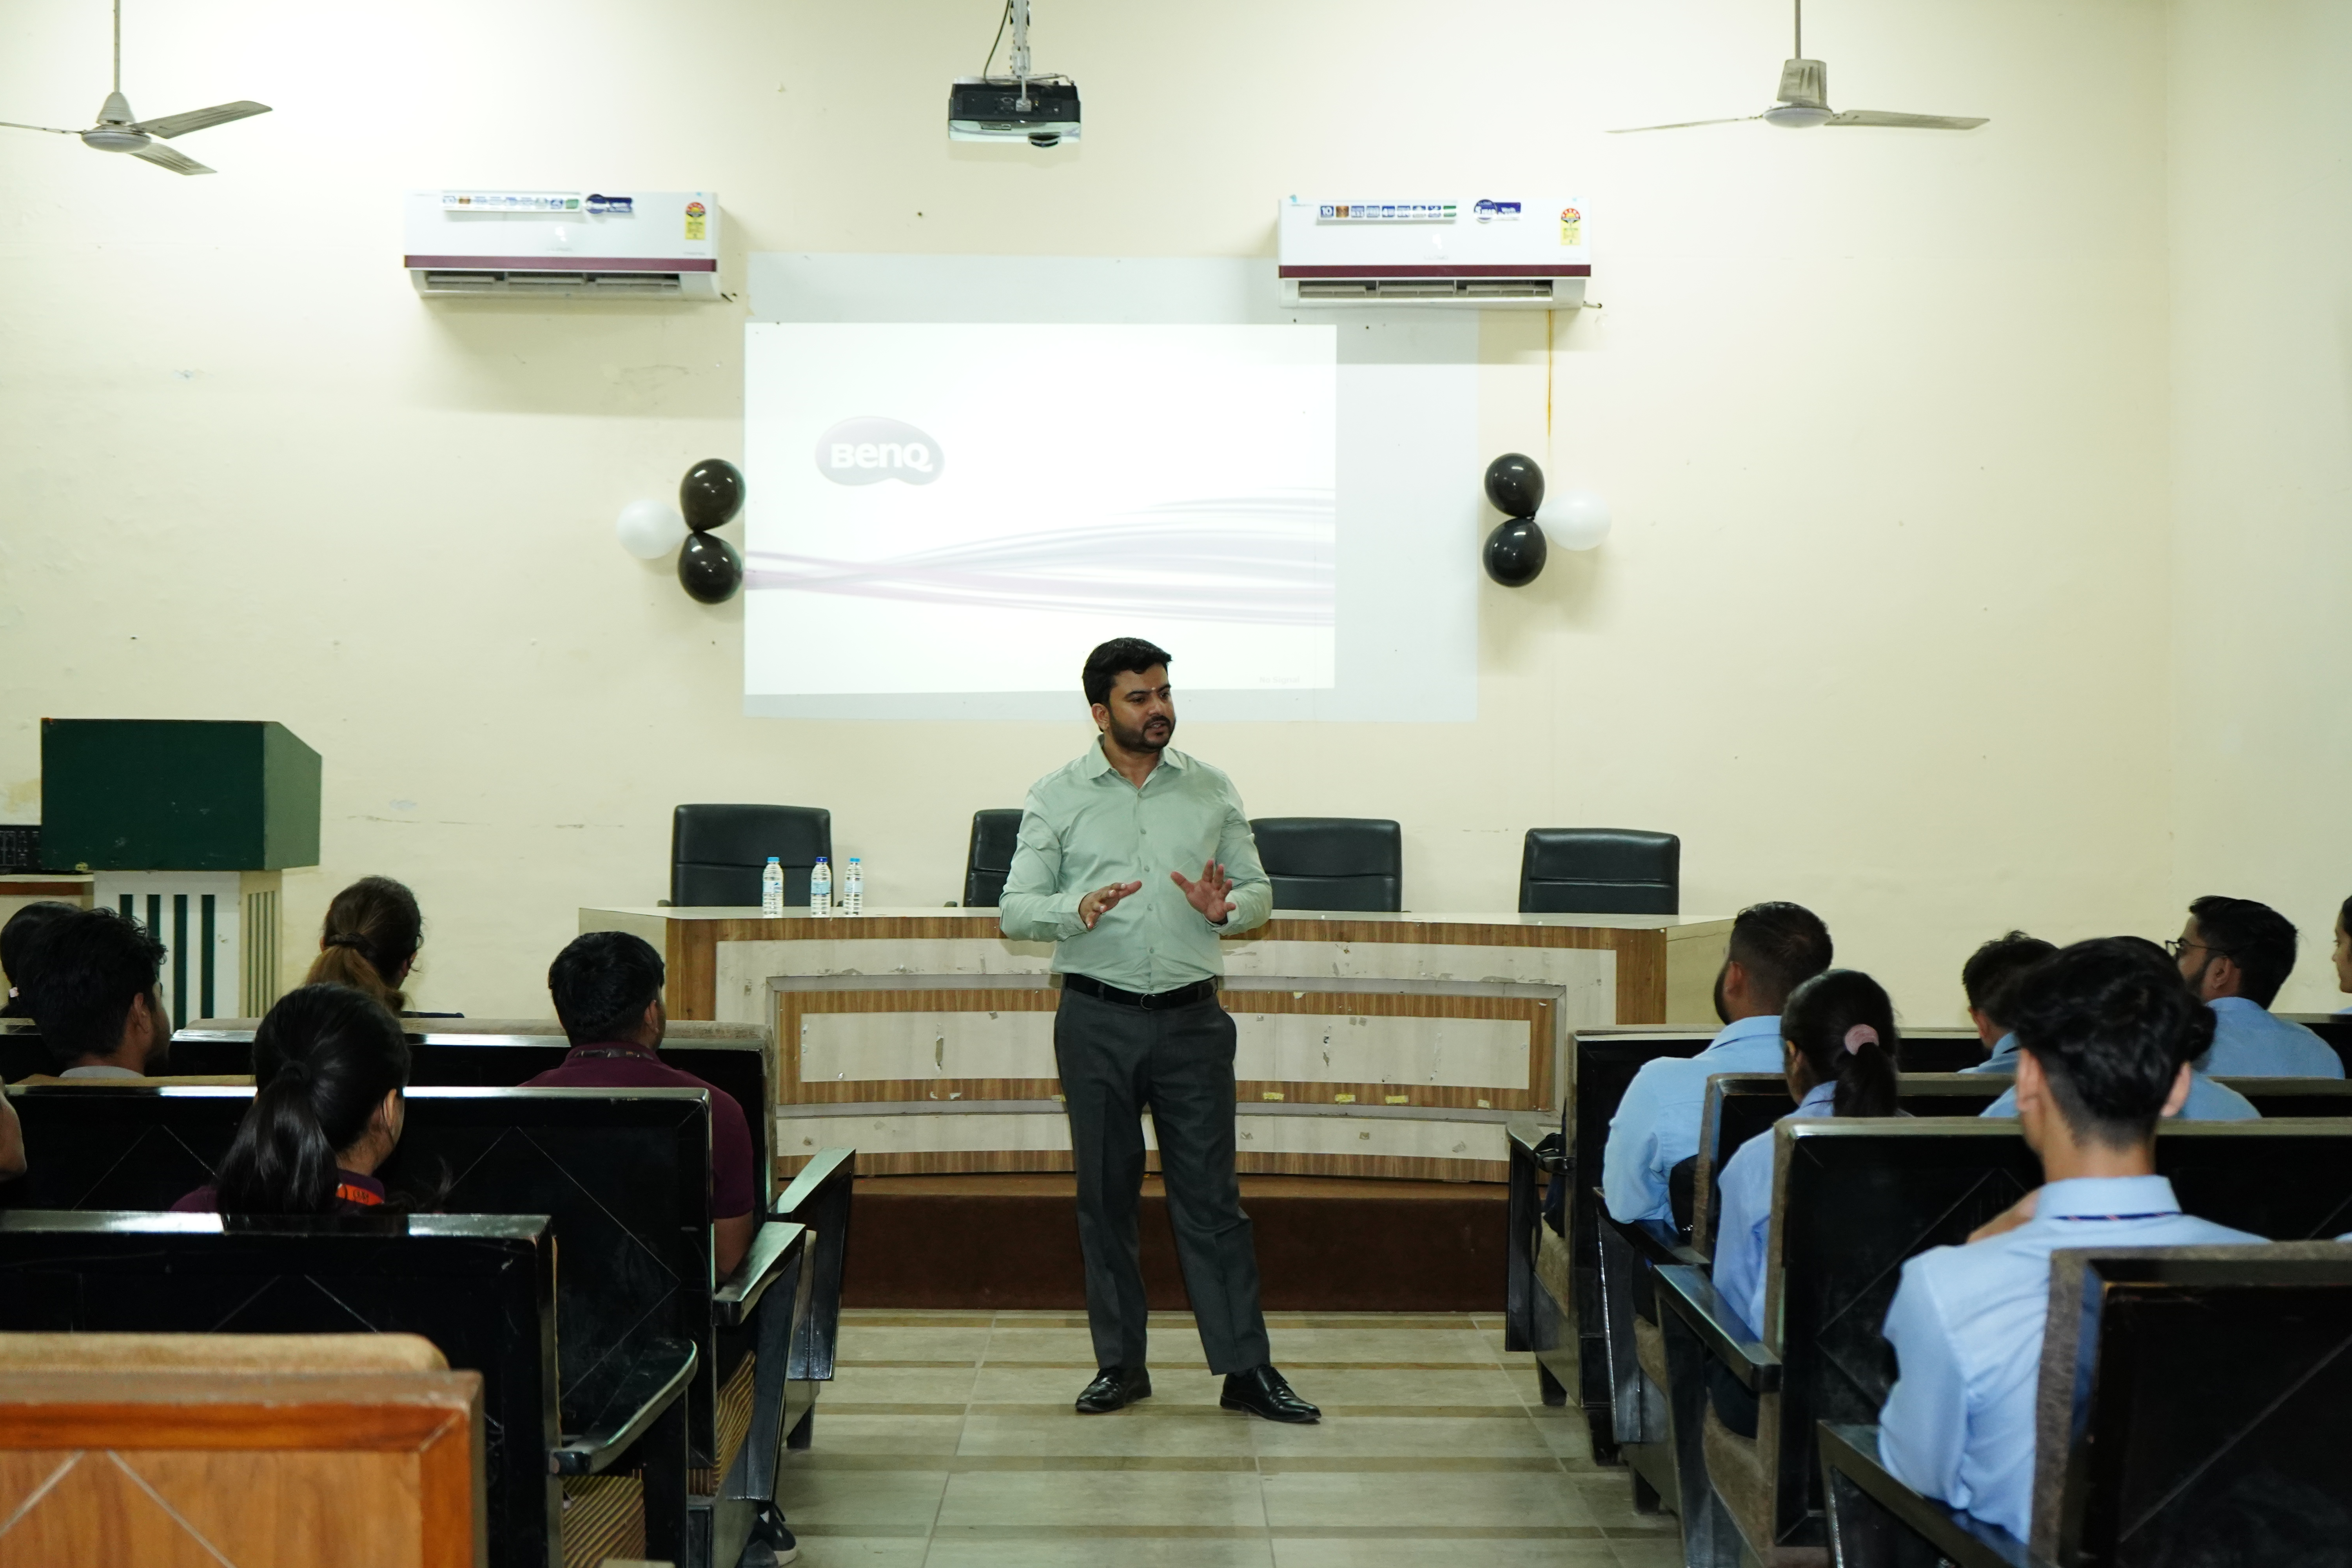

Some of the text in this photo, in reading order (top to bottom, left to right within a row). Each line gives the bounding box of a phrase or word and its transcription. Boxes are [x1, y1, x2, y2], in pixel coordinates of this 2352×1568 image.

[1321, 207, 1332, 215] 10
[831, 443, 933, 472] BenQ
[1273, 676, 1299, 684] Signal
